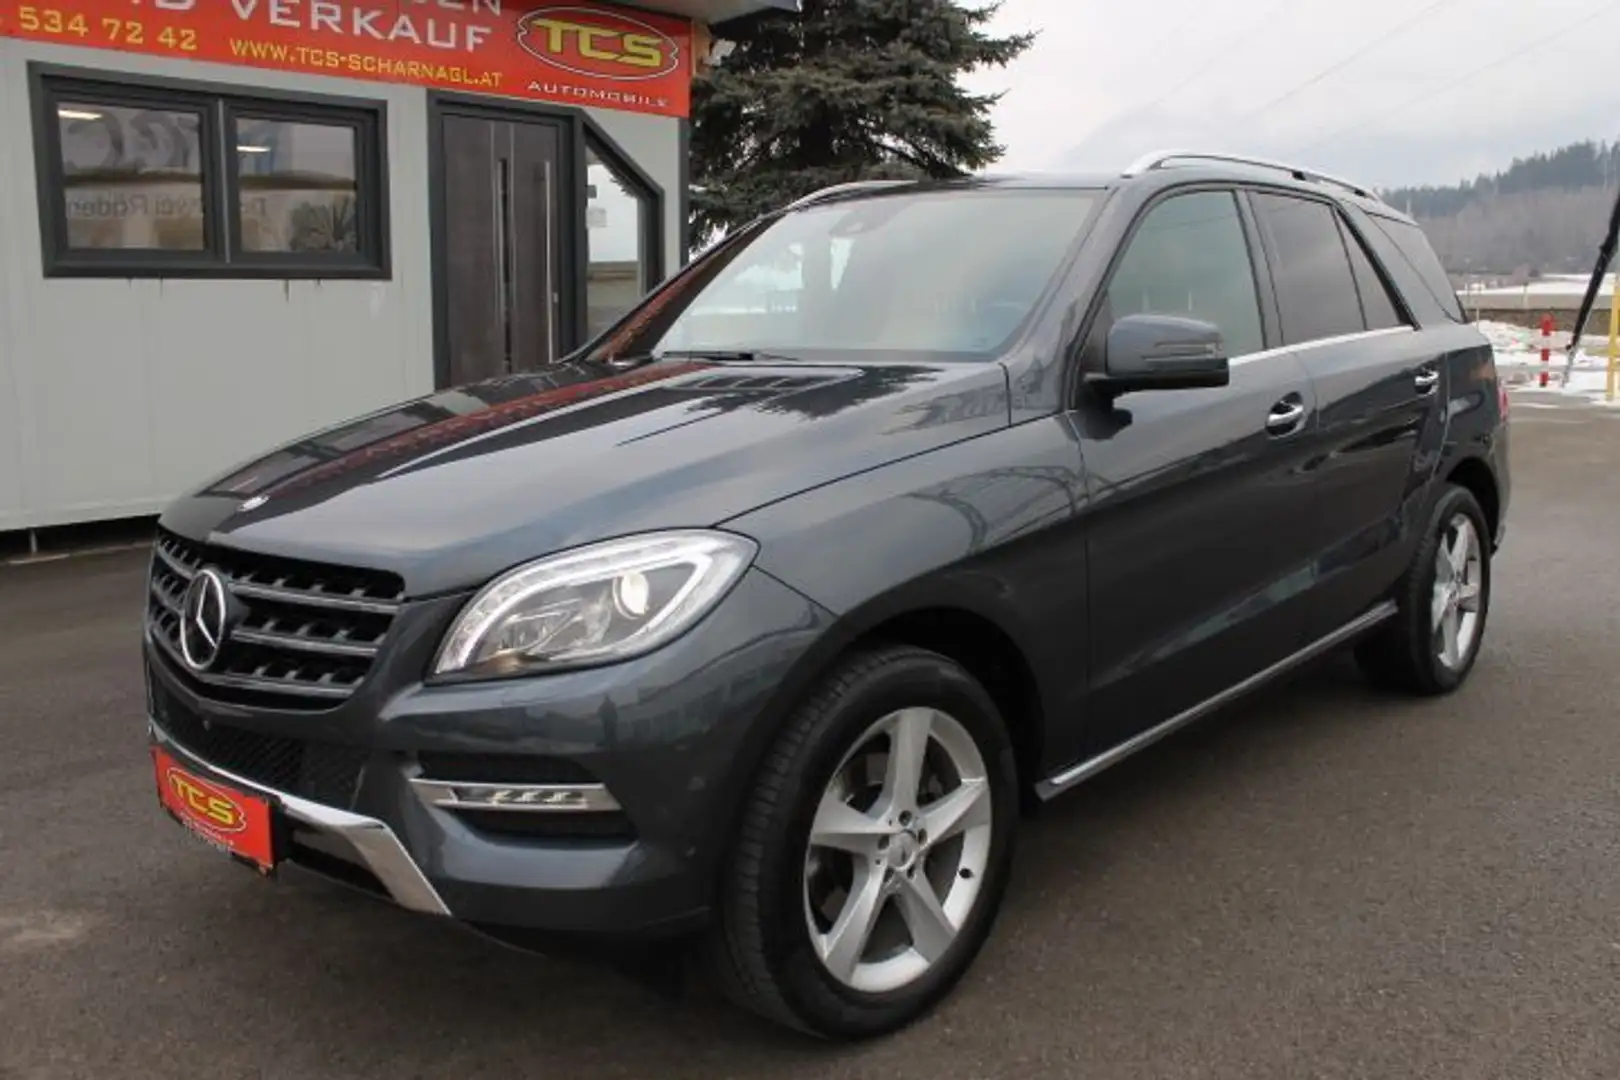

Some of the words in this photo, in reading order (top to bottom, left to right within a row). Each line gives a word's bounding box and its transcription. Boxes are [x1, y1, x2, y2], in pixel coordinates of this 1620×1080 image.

[19, 5, 89, 37] 534
[102, 17, 144, 45] 72
[157, 26, 198, 51] 42
[231, 0, 492, 53] VERKAUF
[531, 18, 664, 68] TCS
[170, 774, 235, 825] TCS
